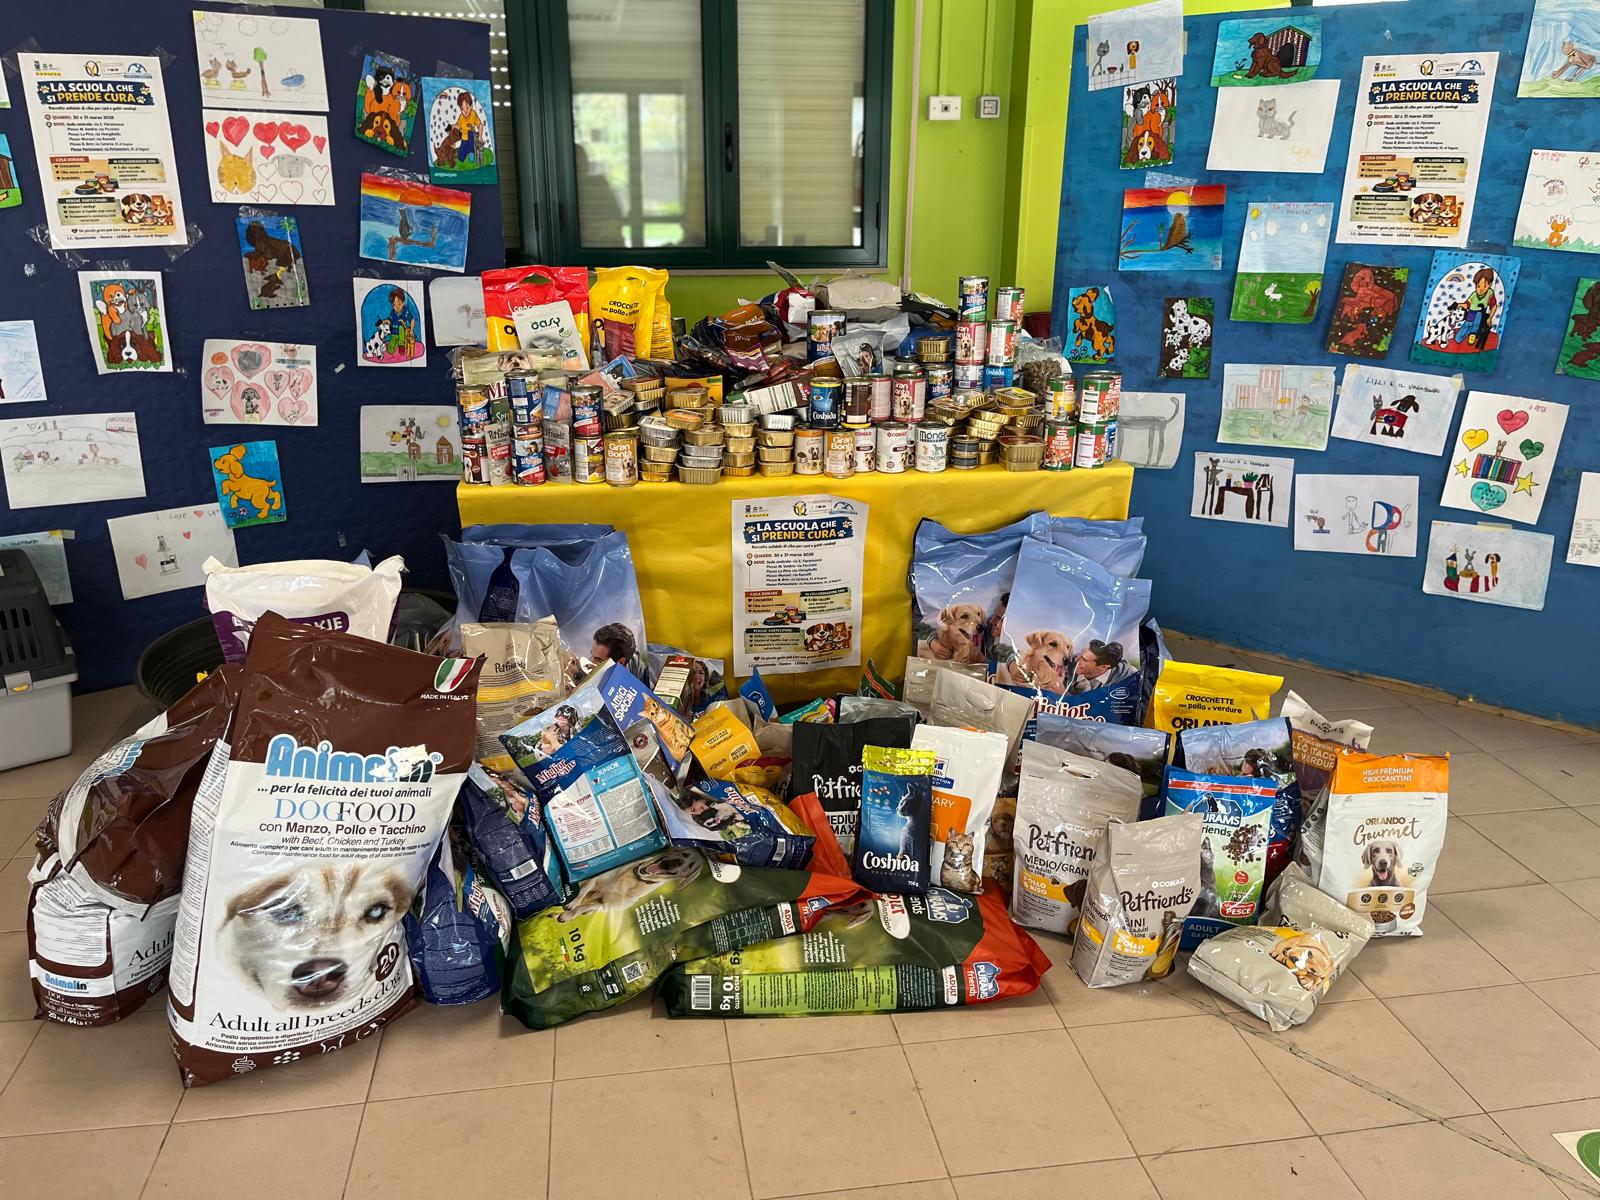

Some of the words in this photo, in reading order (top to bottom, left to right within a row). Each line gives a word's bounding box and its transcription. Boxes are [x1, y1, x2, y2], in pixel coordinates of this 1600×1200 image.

[50, 83, 66, 92] LA
[68, 83, 114, 92] SCUOLA
[1382, 83, 1396, 92] LA
[1399, 82, 1442, 91] SCUOLA
[57, 93, 102, 102] PRENDE
[104, 93, 136, 102] CURA
[1385, 92, 1428, 101] PRENDE
[1430, 91, 1460, 100] CURA
[531, 317, 560, 330] oasy
[812, 411, 836, 420] Coshida
[757, 523, 771, 531] LA
[775, 522, 818, 530] SCUOLA
[762, 531, 805, 540] PRENDE
[808, 529, 836, 539] CURA
[1185, 694, 1234, 705] CROCCHETTE
[1188, 703, 1206, 712] pollo
[1212, 705, 1242, 713] verdure
[535, 759, 567, 784] Miglior
[1362, 775, 1412, 783] CROCCANTINI
[270, 783, 292, 794] per
[293, 783, 305, 793] la
[308, 785, 347, 796] felicità
[350, 788, 368, 797] dei
[370, 788, 393, 797] tuoi
[395, 788, 432, 797] animali
[812, 774, 861, 799] Petfrie
[259, 824, 282, 832] con
[286, 822, 331, 835] Manzo,
[335, 824, 366, 834] Pollo
[369, 826, 376, 834] e
[380, 824, 426, 835] Tacchino
[1202, 826, 1231, 837] riends
[1354, 818, 1421, 846] Gourmet
[282, 836, 300, 844] with
[302, 837, 324, 845] Beef,
[328, 837, 361, 845] Chicken
[380, 838, 406, 846] Turkey
[862, 851, 919, 873] Coshida
[1024, 854, 1089, 876] MEDIO/GRAN
[1024, 875, 1046, 889] POLLO
[1158, 878, 1185, 888] CONAD
[1120, 886, 1194, 911] Petfriends
[1225, 907, 1252, 916] PESCE
[784, 910, 794, 931] ADULT
[568, 926, 581, 941] 10
[1188, 924, 1220, 933] ADULT
[379, 946, 397, 971] 20
[572, 945, 587, 963] kg
[45, 973, 87, 990] Animalin
[722, 975, 733, 992] 10
[947, 974, 956, 998] ADULT
[975, 964, 988, 998] PURAMS
[209, 1013, 271, 1032] Adult
[275, 1015, 299, 1031] all
[306, 996, 372, 1028] breeds
[374, 970, 401, 1000] dog
[719, 993, 731, 1011] kg
